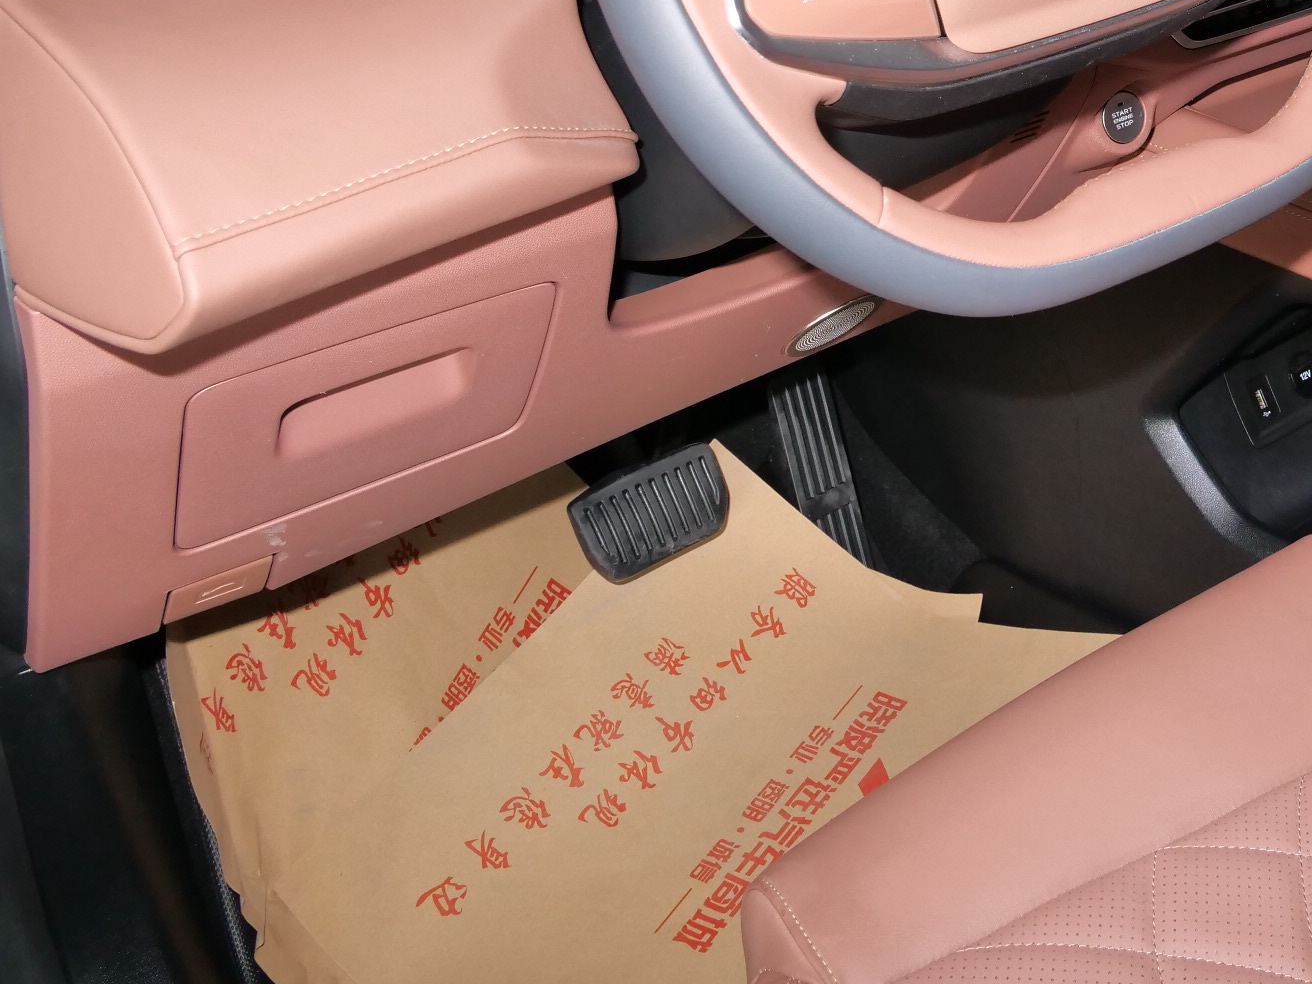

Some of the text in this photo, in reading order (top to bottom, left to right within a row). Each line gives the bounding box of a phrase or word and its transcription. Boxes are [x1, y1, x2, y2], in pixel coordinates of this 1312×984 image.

[1111, 106, 1133, 119] START
[1113, 113, 1134, 125] ENGINE
[1116, 119, 1134, 130] STOP
[1300, 369, 1311, 381] 12V
[577, 567, 817, 828] 服务从细节体现
[416, 637, 690, 917] 满意就在您身边
[672, 691, 908, 954] 晓波严选汽车商城
